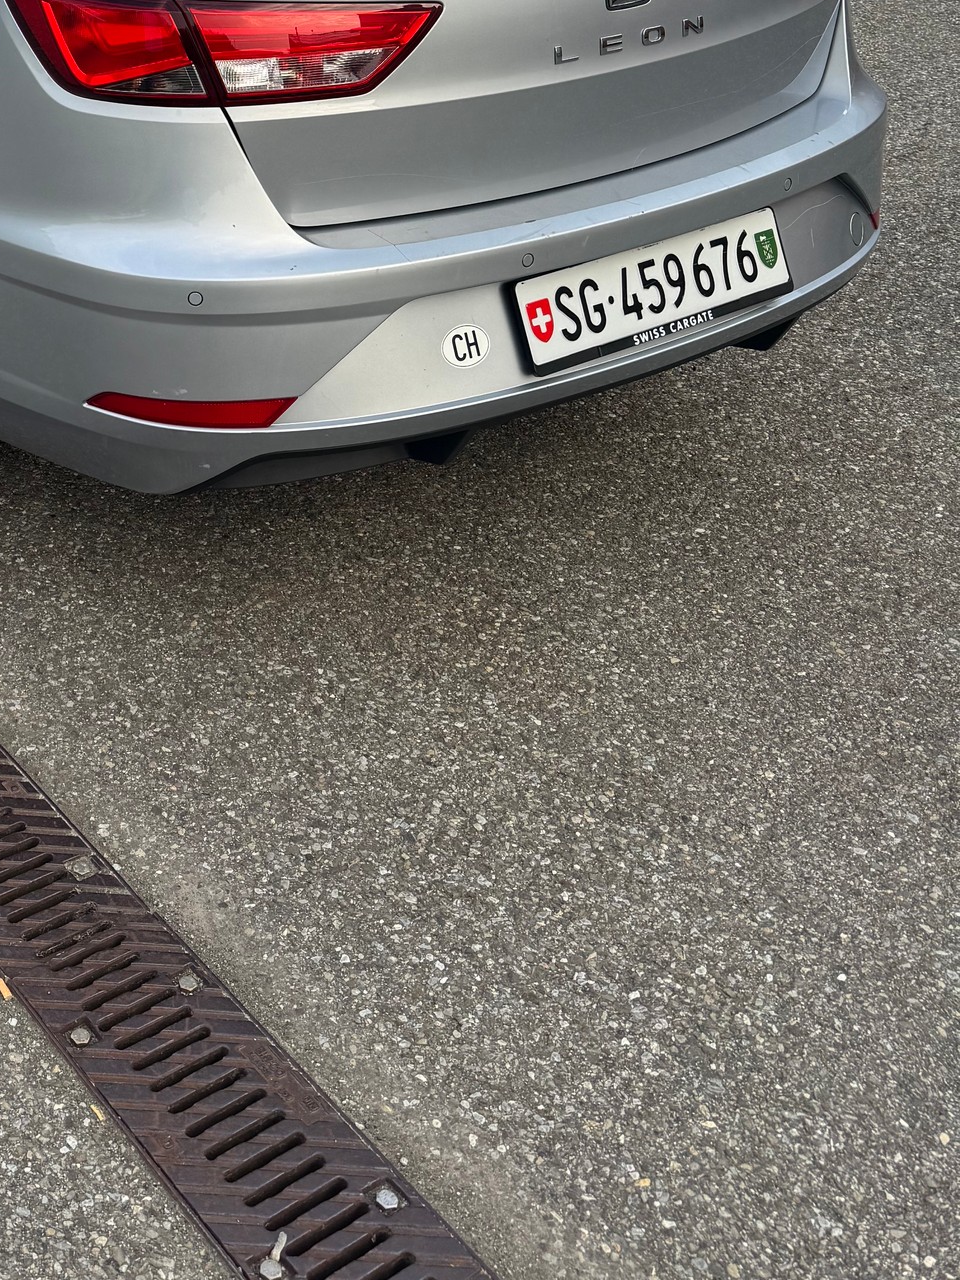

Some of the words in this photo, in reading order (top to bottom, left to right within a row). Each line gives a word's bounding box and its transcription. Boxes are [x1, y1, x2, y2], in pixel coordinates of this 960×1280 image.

[553, 15, 704, 65] LEON
[633, 326, 666, 345] SWISS
[669, 310, 714, 333] CARGATE
[452, 330, 481, 362] CH
